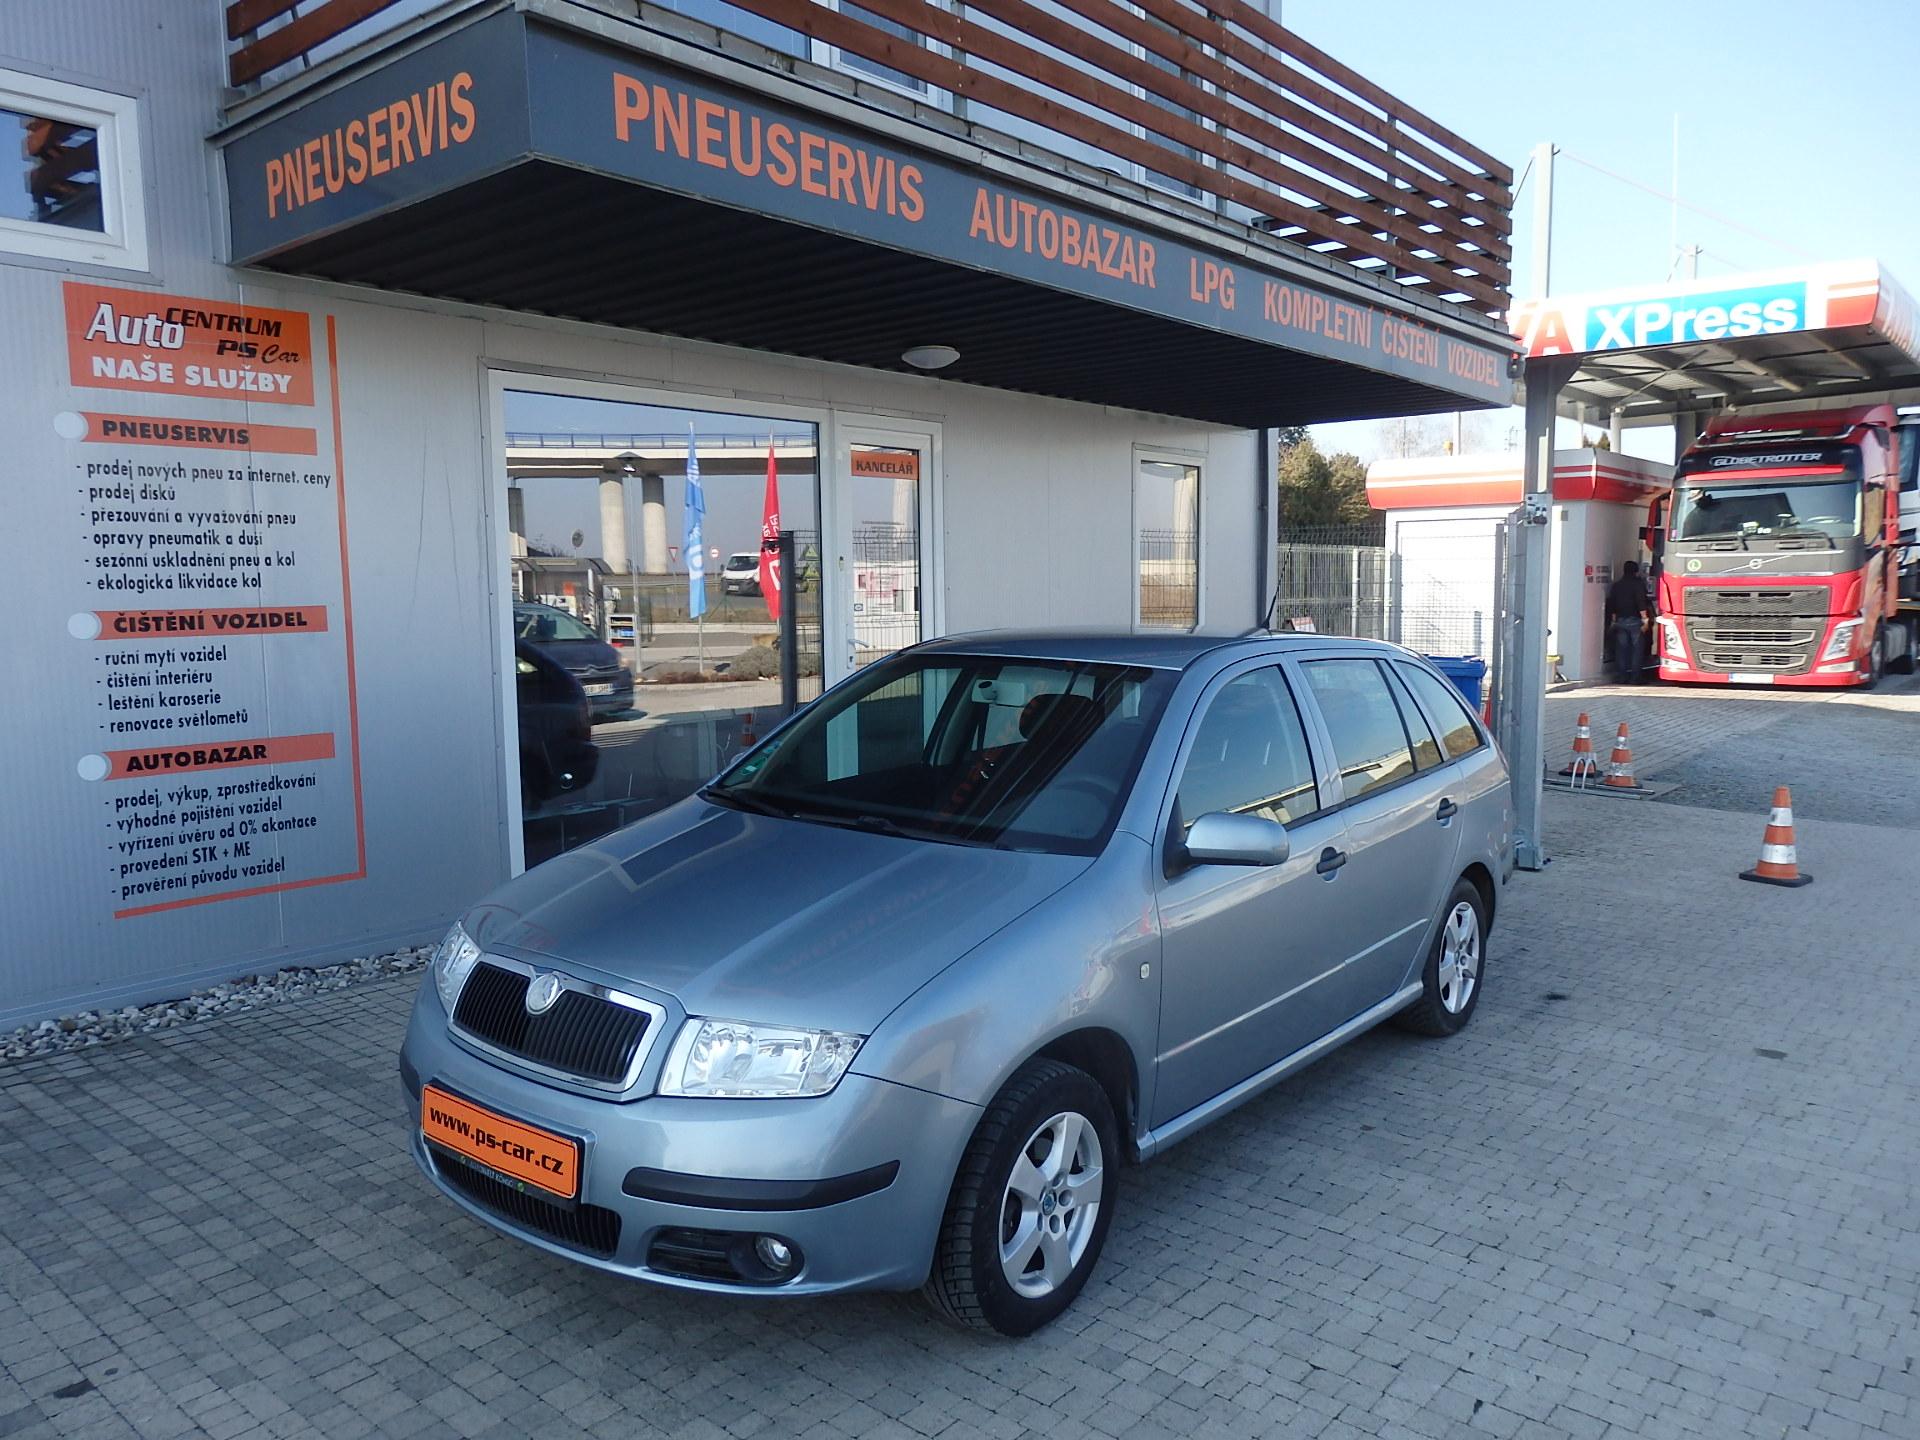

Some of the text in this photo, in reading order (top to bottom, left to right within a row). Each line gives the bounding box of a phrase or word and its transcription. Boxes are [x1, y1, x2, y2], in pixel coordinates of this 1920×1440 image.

[266, 71, 476, 218] PNEUSERVIS
[613, 71, 1500, 387] PNEUSERVIS AUTOBAZAR LPG KOMPLETNÍ ČIŠTĚNÍ VOZIDEL
[84, 302, 281, 350] Auto CENTRUM
[1594, 298, 1798, 351] XPress
[217, 339, 300, 364] PS Car
[92, 354, 292, 394] NAŠE SLUŽBY
[102, 419, 250, 445] PNEUSERVIS
[855, 459, 914, 475] KANCELÁŘ
[1711, 453, 1822, 466] GLOBETROTTER
[87, 458, 133, 480] prodej
[138, 461, 187, 482] nových
[191, 467, 223, 482] pneu
[228, 469, 243, 480] za
[303, 473, 331, 488] ceny
[89, 482, 135, 504] prodej
[91, 507, 296, 528] přezouvání a vyvažování pneu
[93, 533, 144, 549] opravy
[149, 529, 221, 549] pneumatik
[225, 534, 233, 545] a
[95, 550, 295, 571] sezónní uskladnění pneu a kol
[97, 571, 261, 594] ekologická likvidace kol
[113, 611, 308, 634] ČIŠTĚNÍ VOZIDEL
[105, 649, 140, 666] ruční
[180, 644, 227, 663] vozidel
[107, 668, 213, 688] čištění interiéru
[108, 688, 221, 711] leštění karoserie
[110, 708, 249, 733] renovace světlometů
[126, 744, 268, 772] AUTOBAZAR
[115, 772, 316, 813] prodej, výkup, zprostředkování
[117, 795, 283, 834] výhodné pojištění vozidel
[118, 815, 317, 856] vyřízení úvěru od 0% akontace
[120, 851, 188, 879] provedení
[192, 845, 218, 864] STK
[233, 841, 251, 858] ME
[121, 856, 286, 900] prověření původu vozidel
[429, 1107, 564, 1176] www.ps-car.cz
